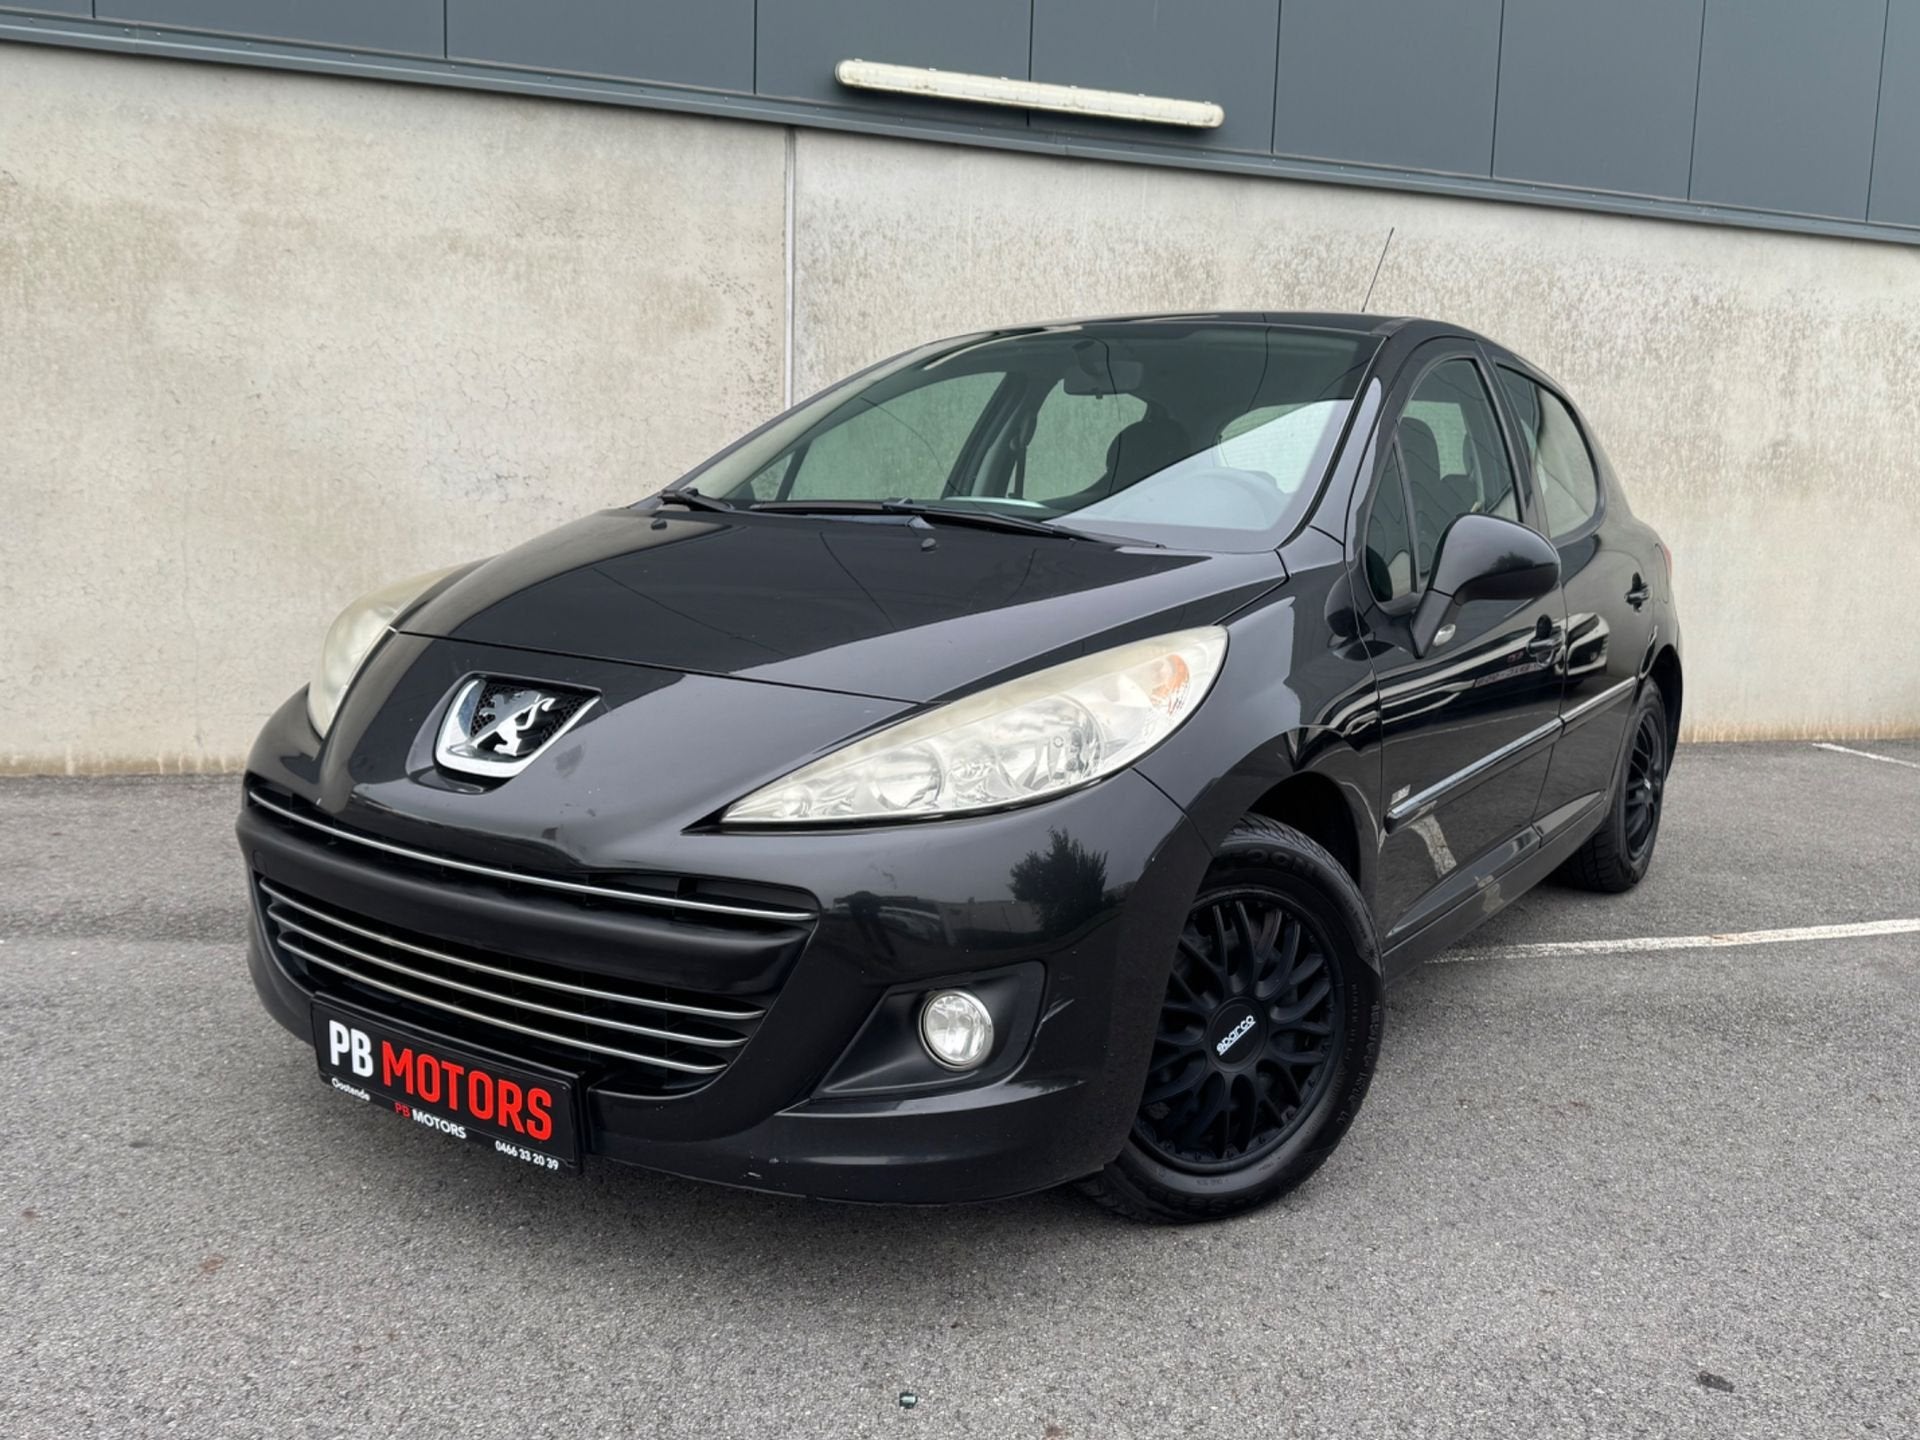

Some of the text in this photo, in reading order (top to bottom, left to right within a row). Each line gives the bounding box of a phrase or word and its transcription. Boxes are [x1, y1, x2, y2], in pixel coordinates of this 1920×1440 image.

[1216, 1014, 1255, 1055] sparco
[328, 1019, 553, 1141] PB MOTORS
[394, 1101, 467, 1139] PB MOTORS
[495, 1140, 518, 1157] 0466
[532, 1153, 545, 1167] 20
[546, 1157, 559, 1171] 39
